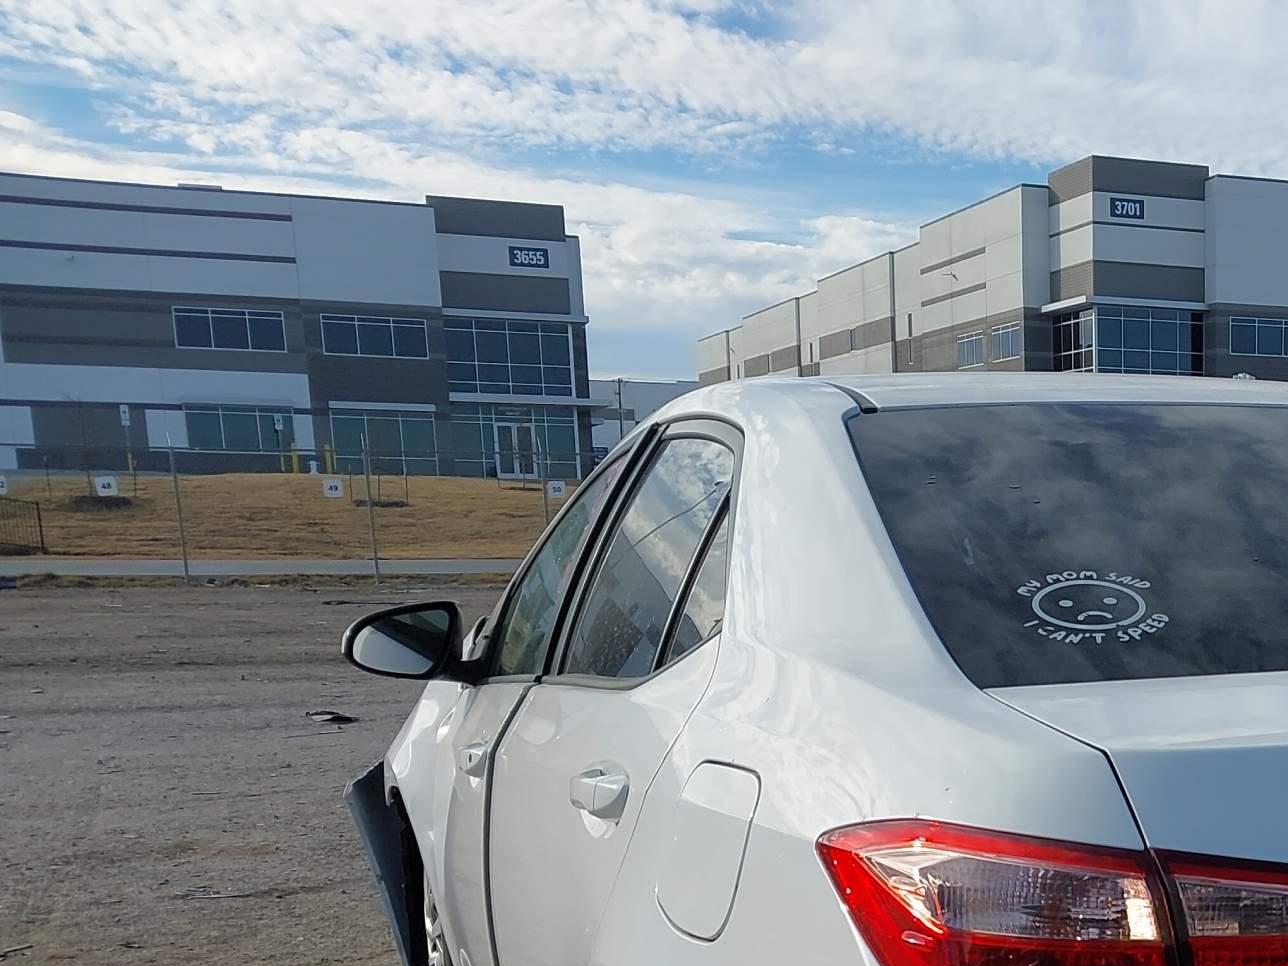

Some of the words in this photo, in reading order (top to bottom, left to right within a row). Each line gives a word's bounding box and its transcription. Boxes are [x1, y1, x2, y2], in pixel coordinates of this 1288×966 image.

[1114, 201, 1140, 216] 3701
[513, 250, 545, 264] 3655
[1016, 579, 1041, 596] MY
[1046, 570, 1097, 583] MOM
[1105, 572, 1151, 588] SAID
[1038, 627, 1106, 644] CAN'T
[1117, 613, 1170, 642] SPEED
